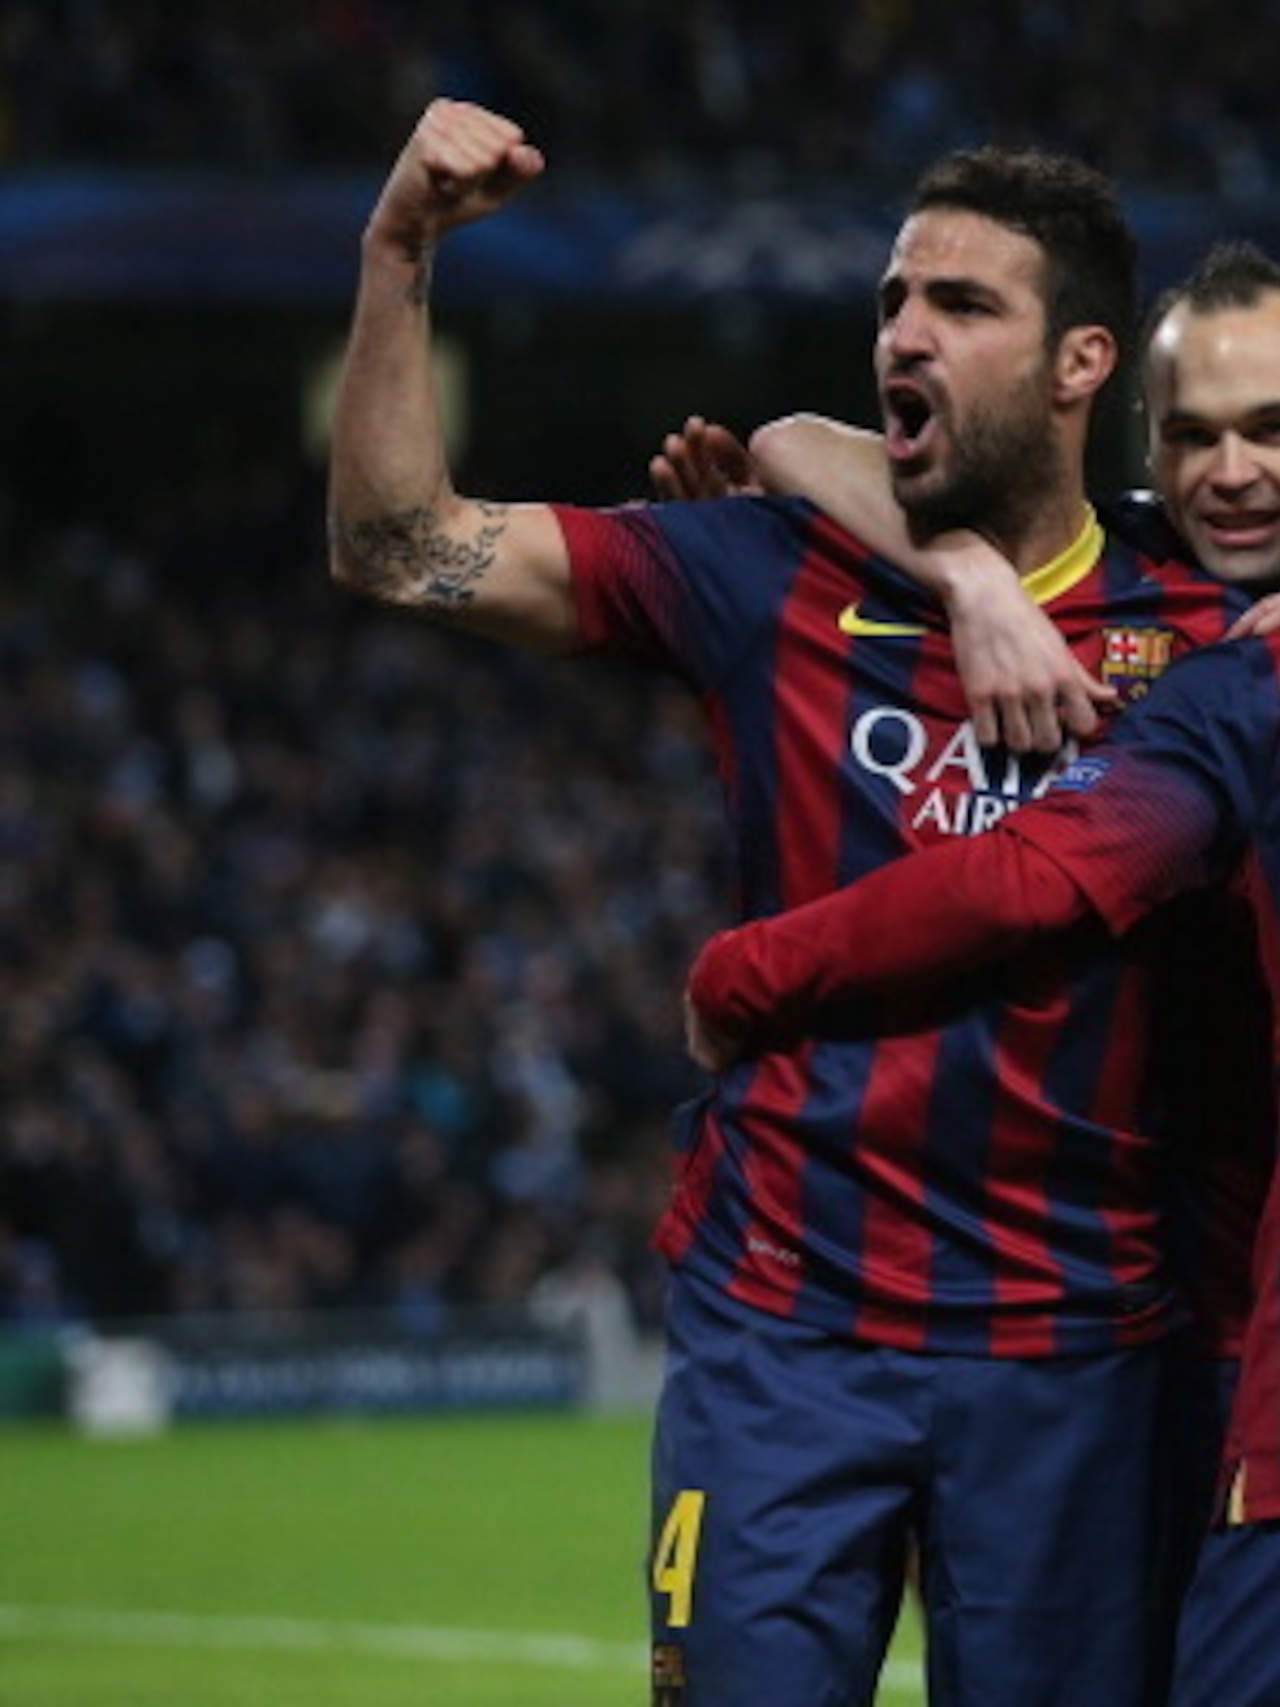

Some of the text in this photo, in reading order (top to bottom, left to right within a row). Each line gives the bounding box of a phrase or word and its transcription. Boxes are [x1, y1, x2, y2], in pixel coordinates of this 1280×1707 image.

[852, 706, 1081, 798] QA
[912, 787, 1020, 836] AIR
[653, 1488, 706, 1628] 4
